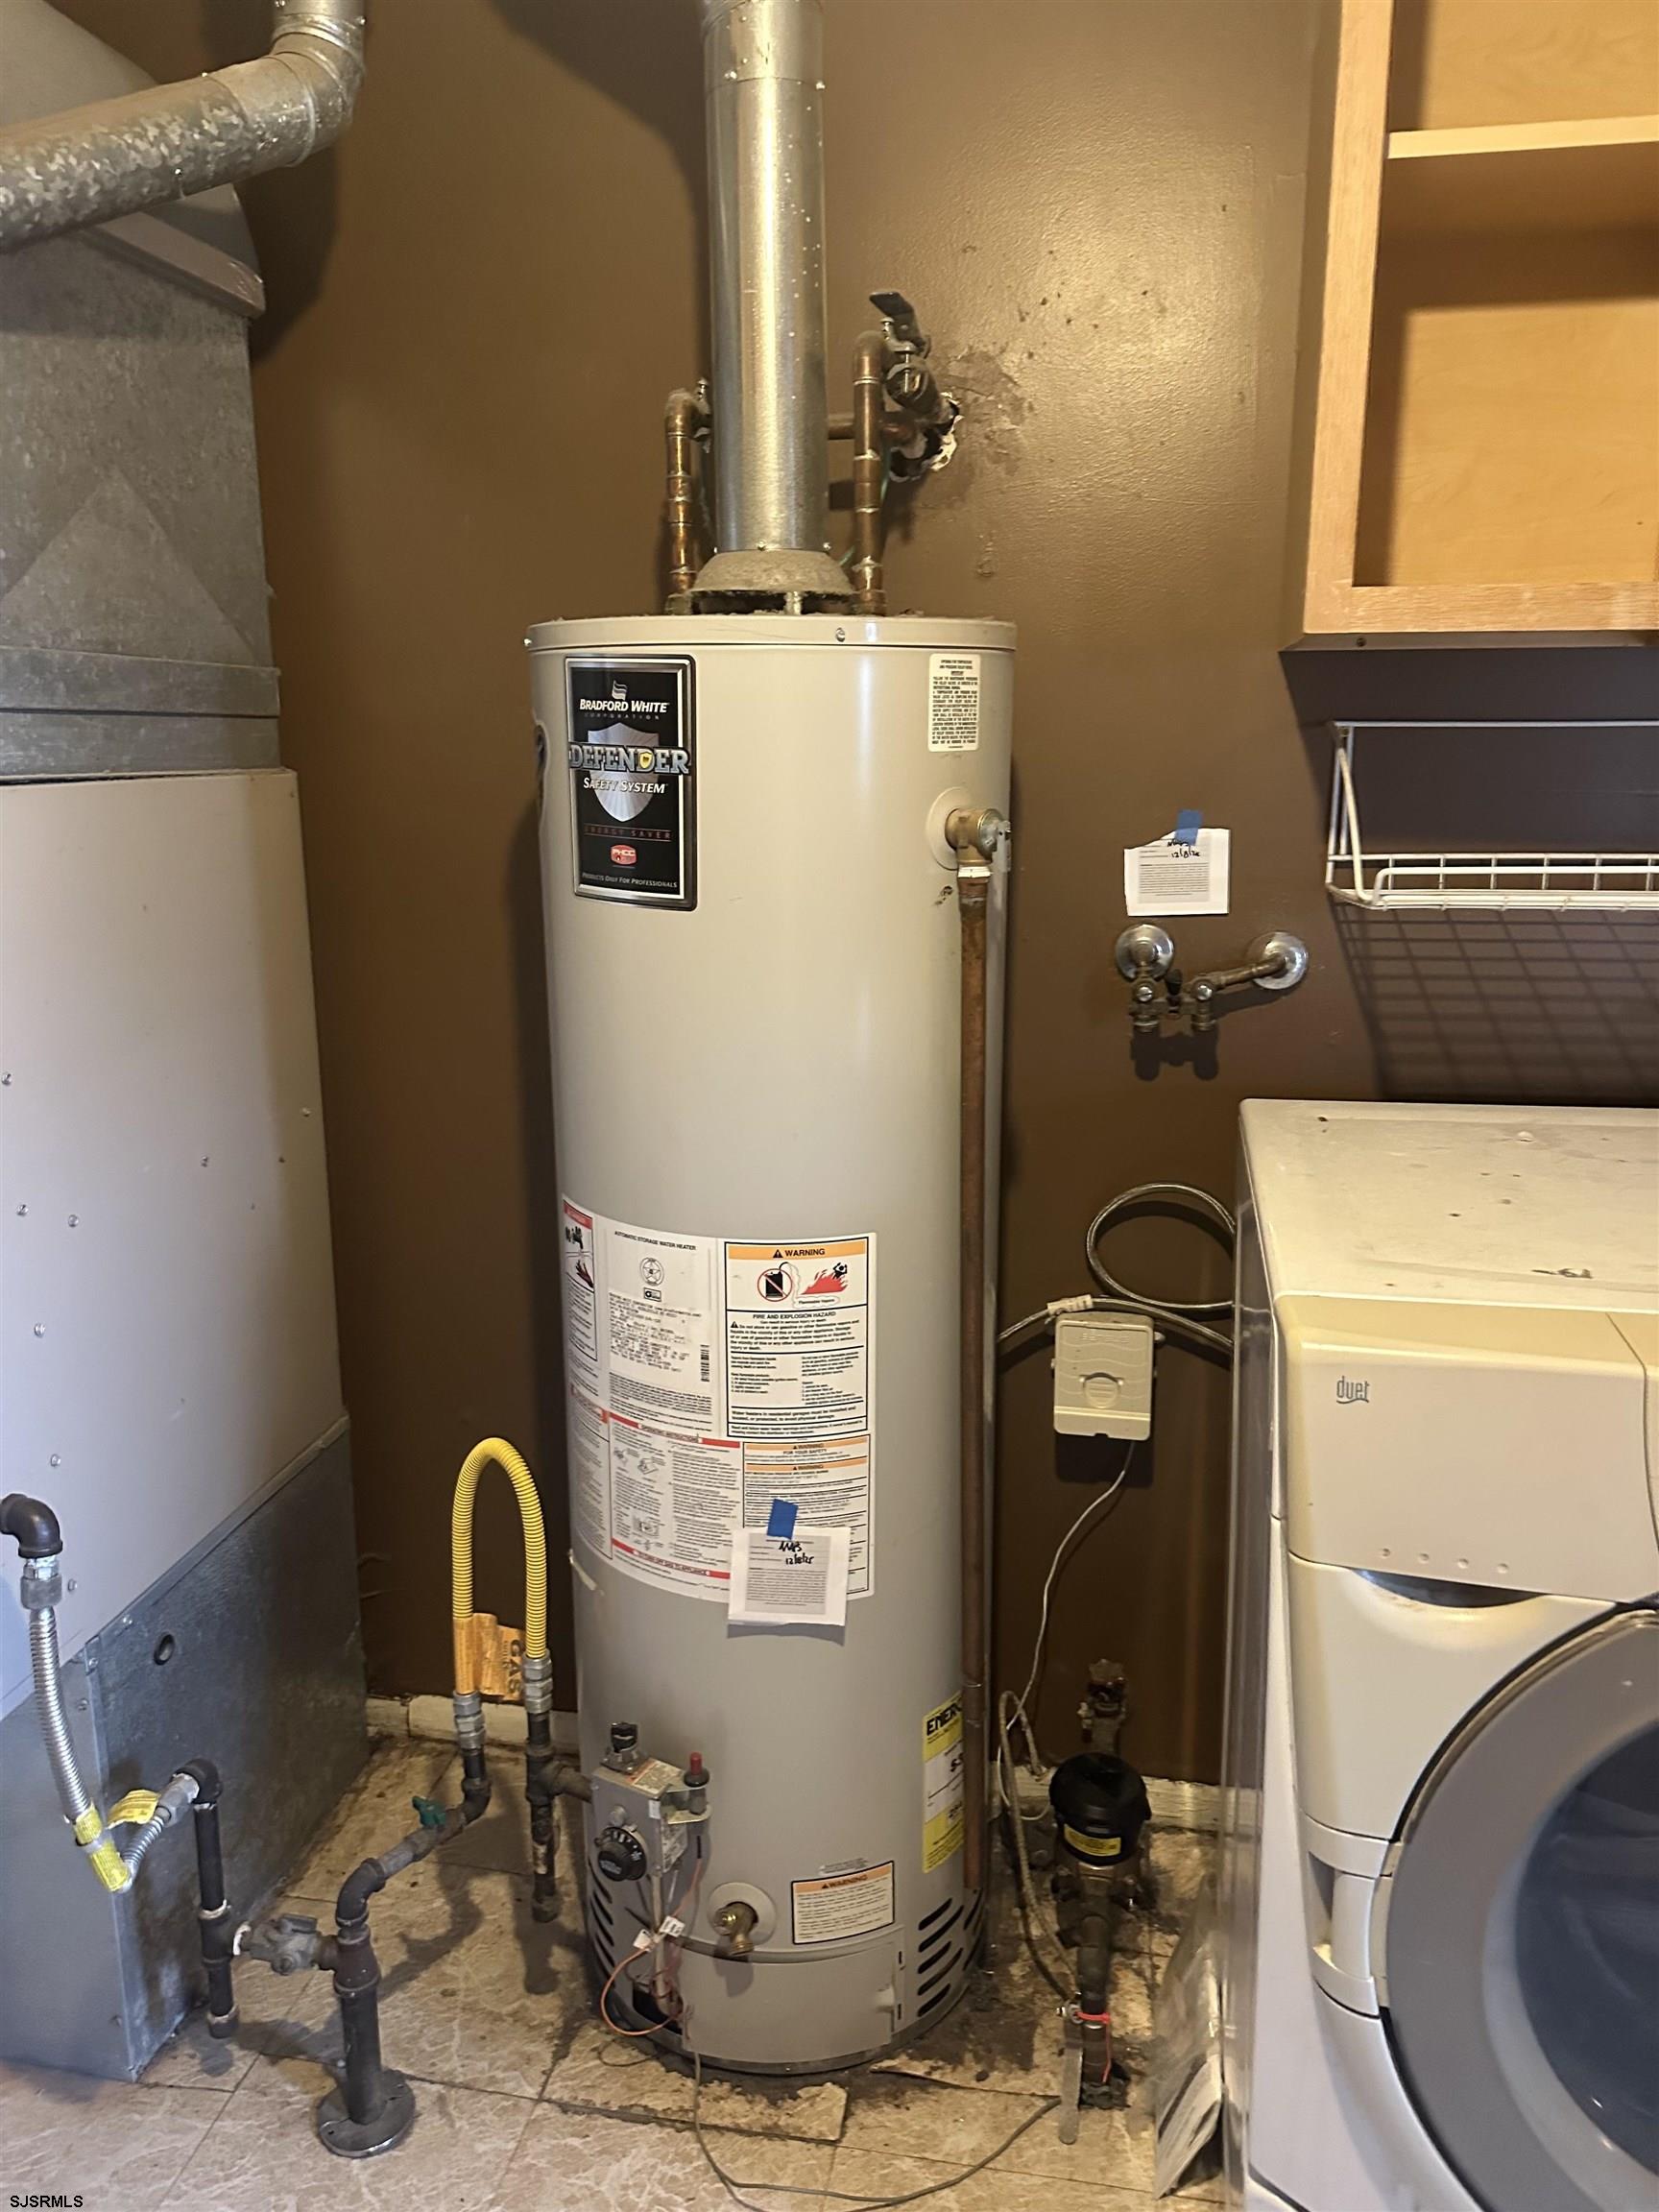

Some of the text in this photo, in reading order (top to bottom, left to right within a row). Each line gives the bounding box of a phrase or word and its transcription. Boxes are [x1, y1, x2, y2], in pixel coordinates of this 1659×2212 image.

[580, 699, 667, 713] BRADFORD WHITE
[568, 743, 689, 774] DEFENDER
[584, 778, 665, 794] SAFETY SYSTEM
[630, 830, 671, 839] SAVER
[784, 1248, 826, 1257] WARNING
[1336, 1375, 1370, 1399] duet
